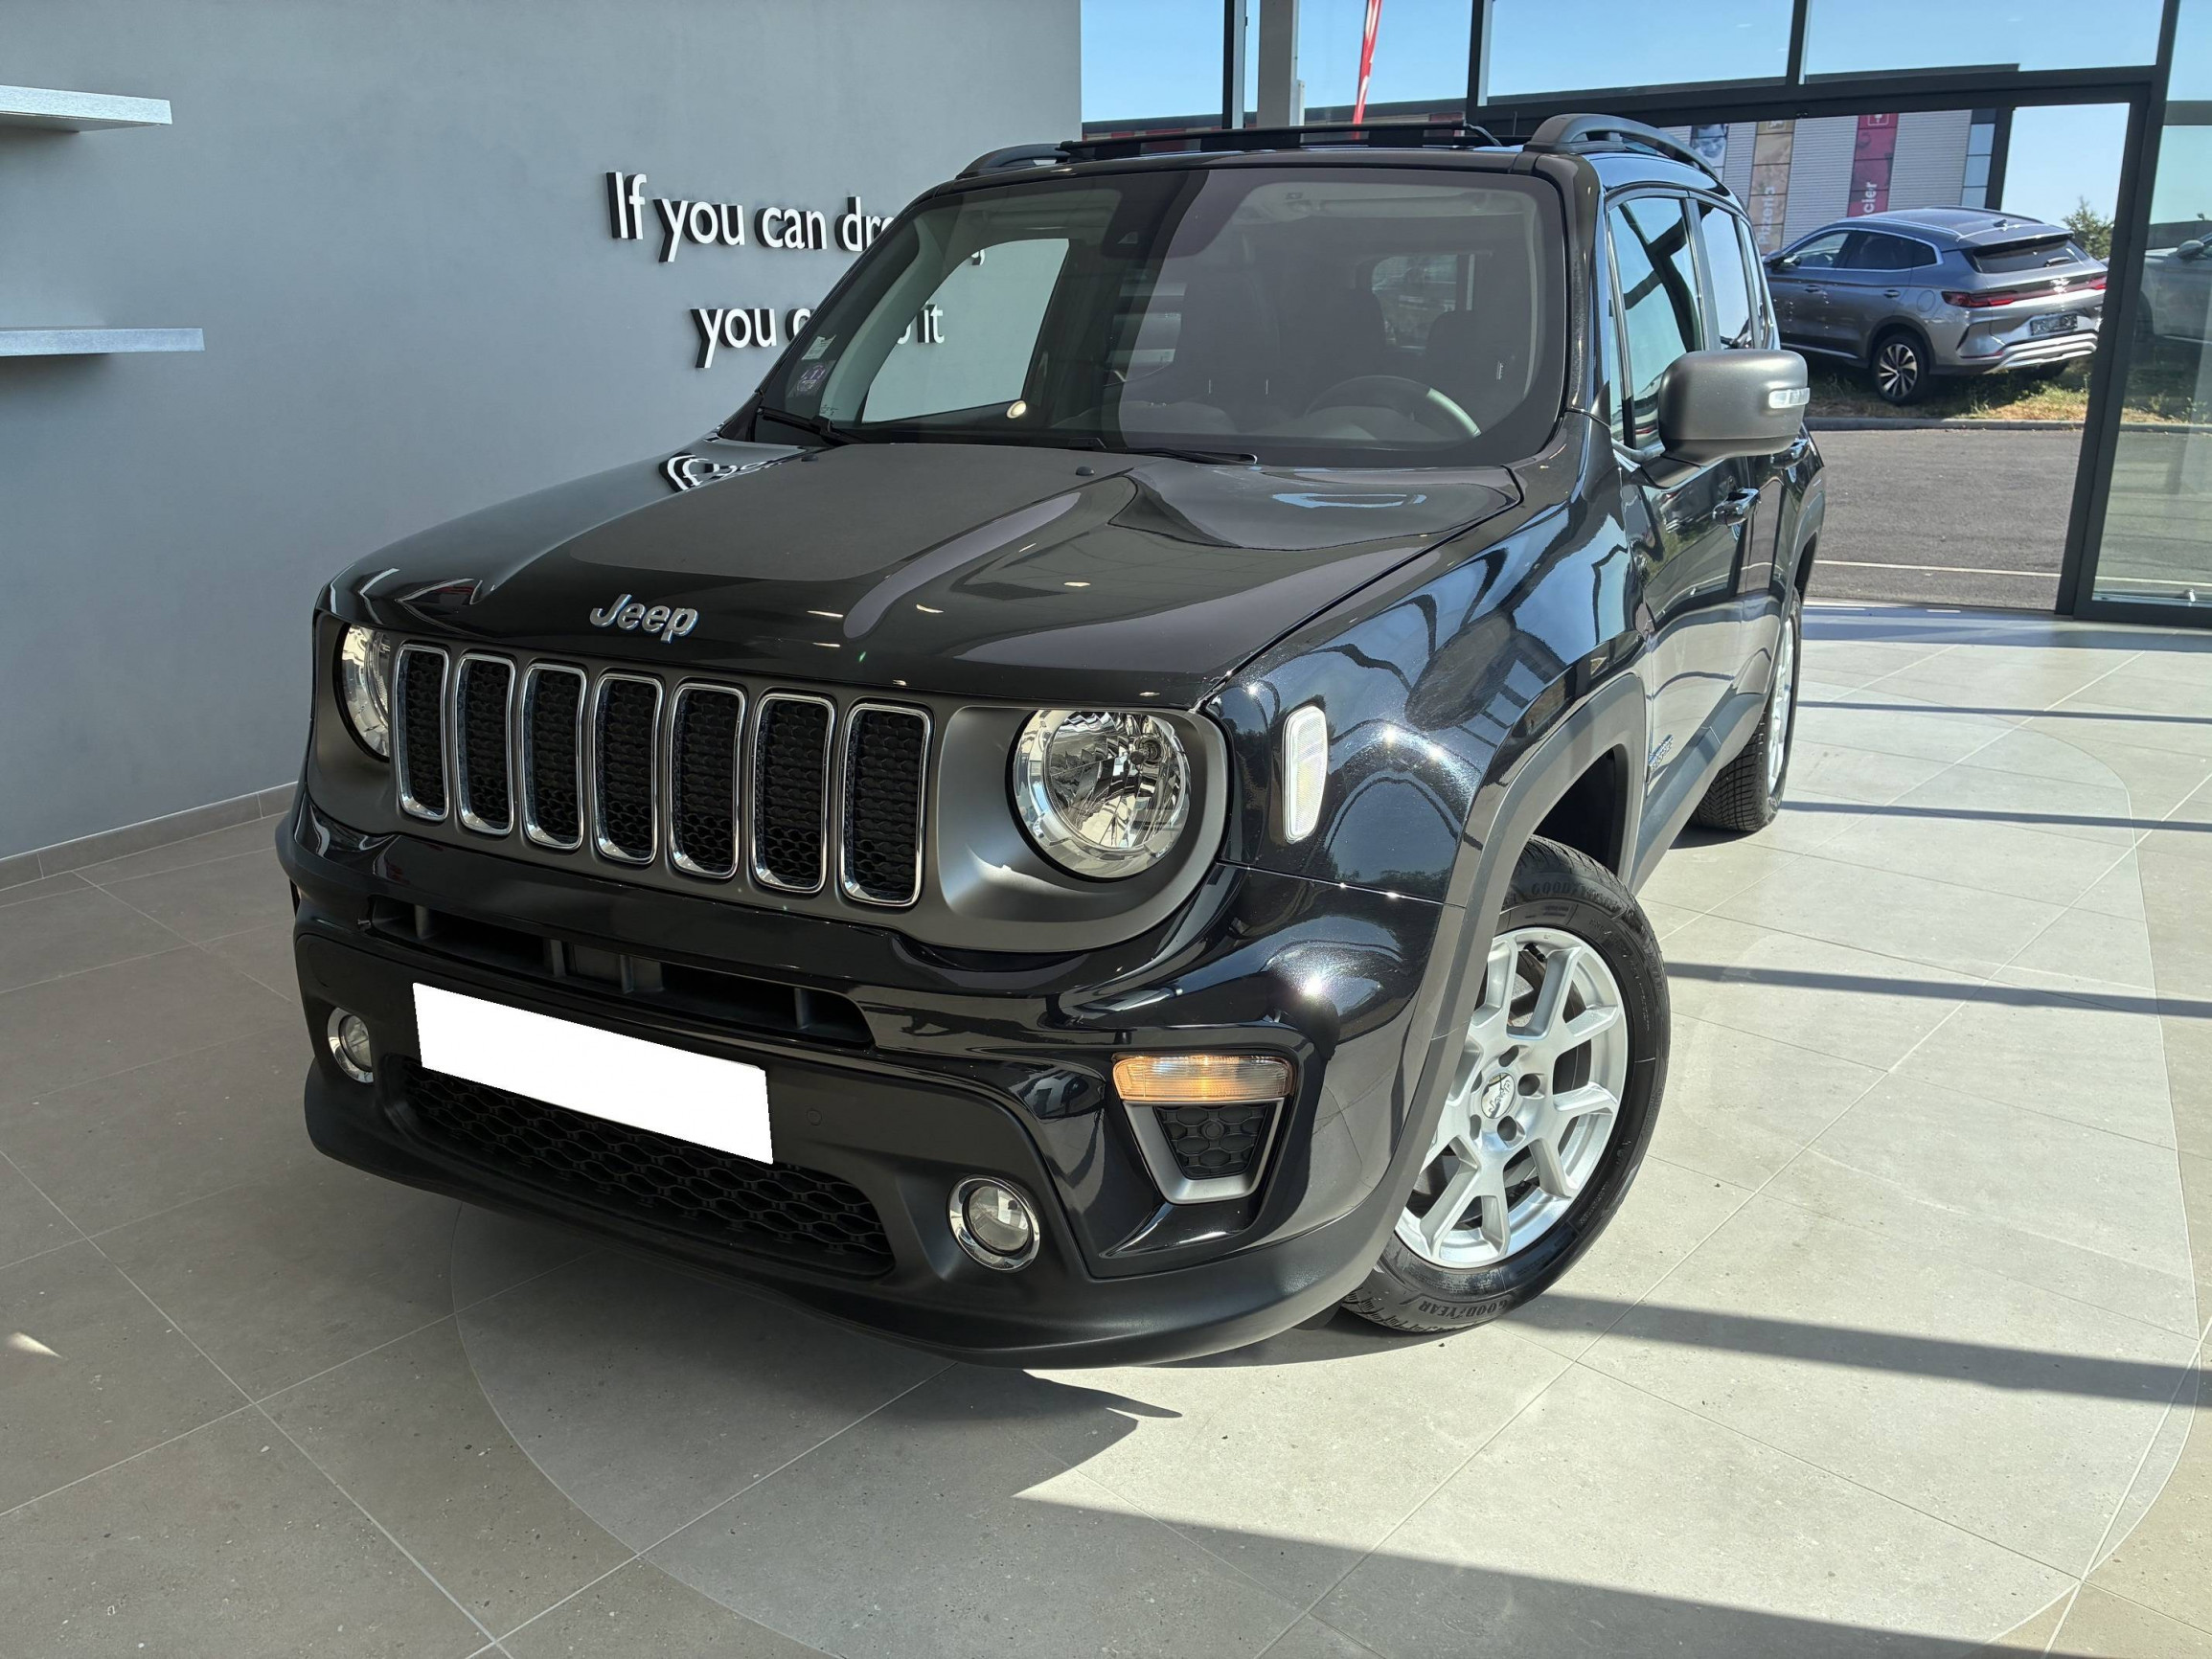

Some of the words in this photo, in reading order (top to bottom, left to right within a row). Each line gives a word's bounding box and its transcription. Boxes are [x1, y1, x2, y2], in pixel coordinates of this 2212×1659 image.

[606, 171, 647, 239] If
[653, 198, 745, 262] you
[754, 208, 827, 250] can
[835, 196, 894, 251] dr
[691, 308, 777, 368] you
[917, 302, 945, 344] it
[589, 594, 699, 644] Jeep
[1418, 1299, 1508, 1320] GOODYEAR
